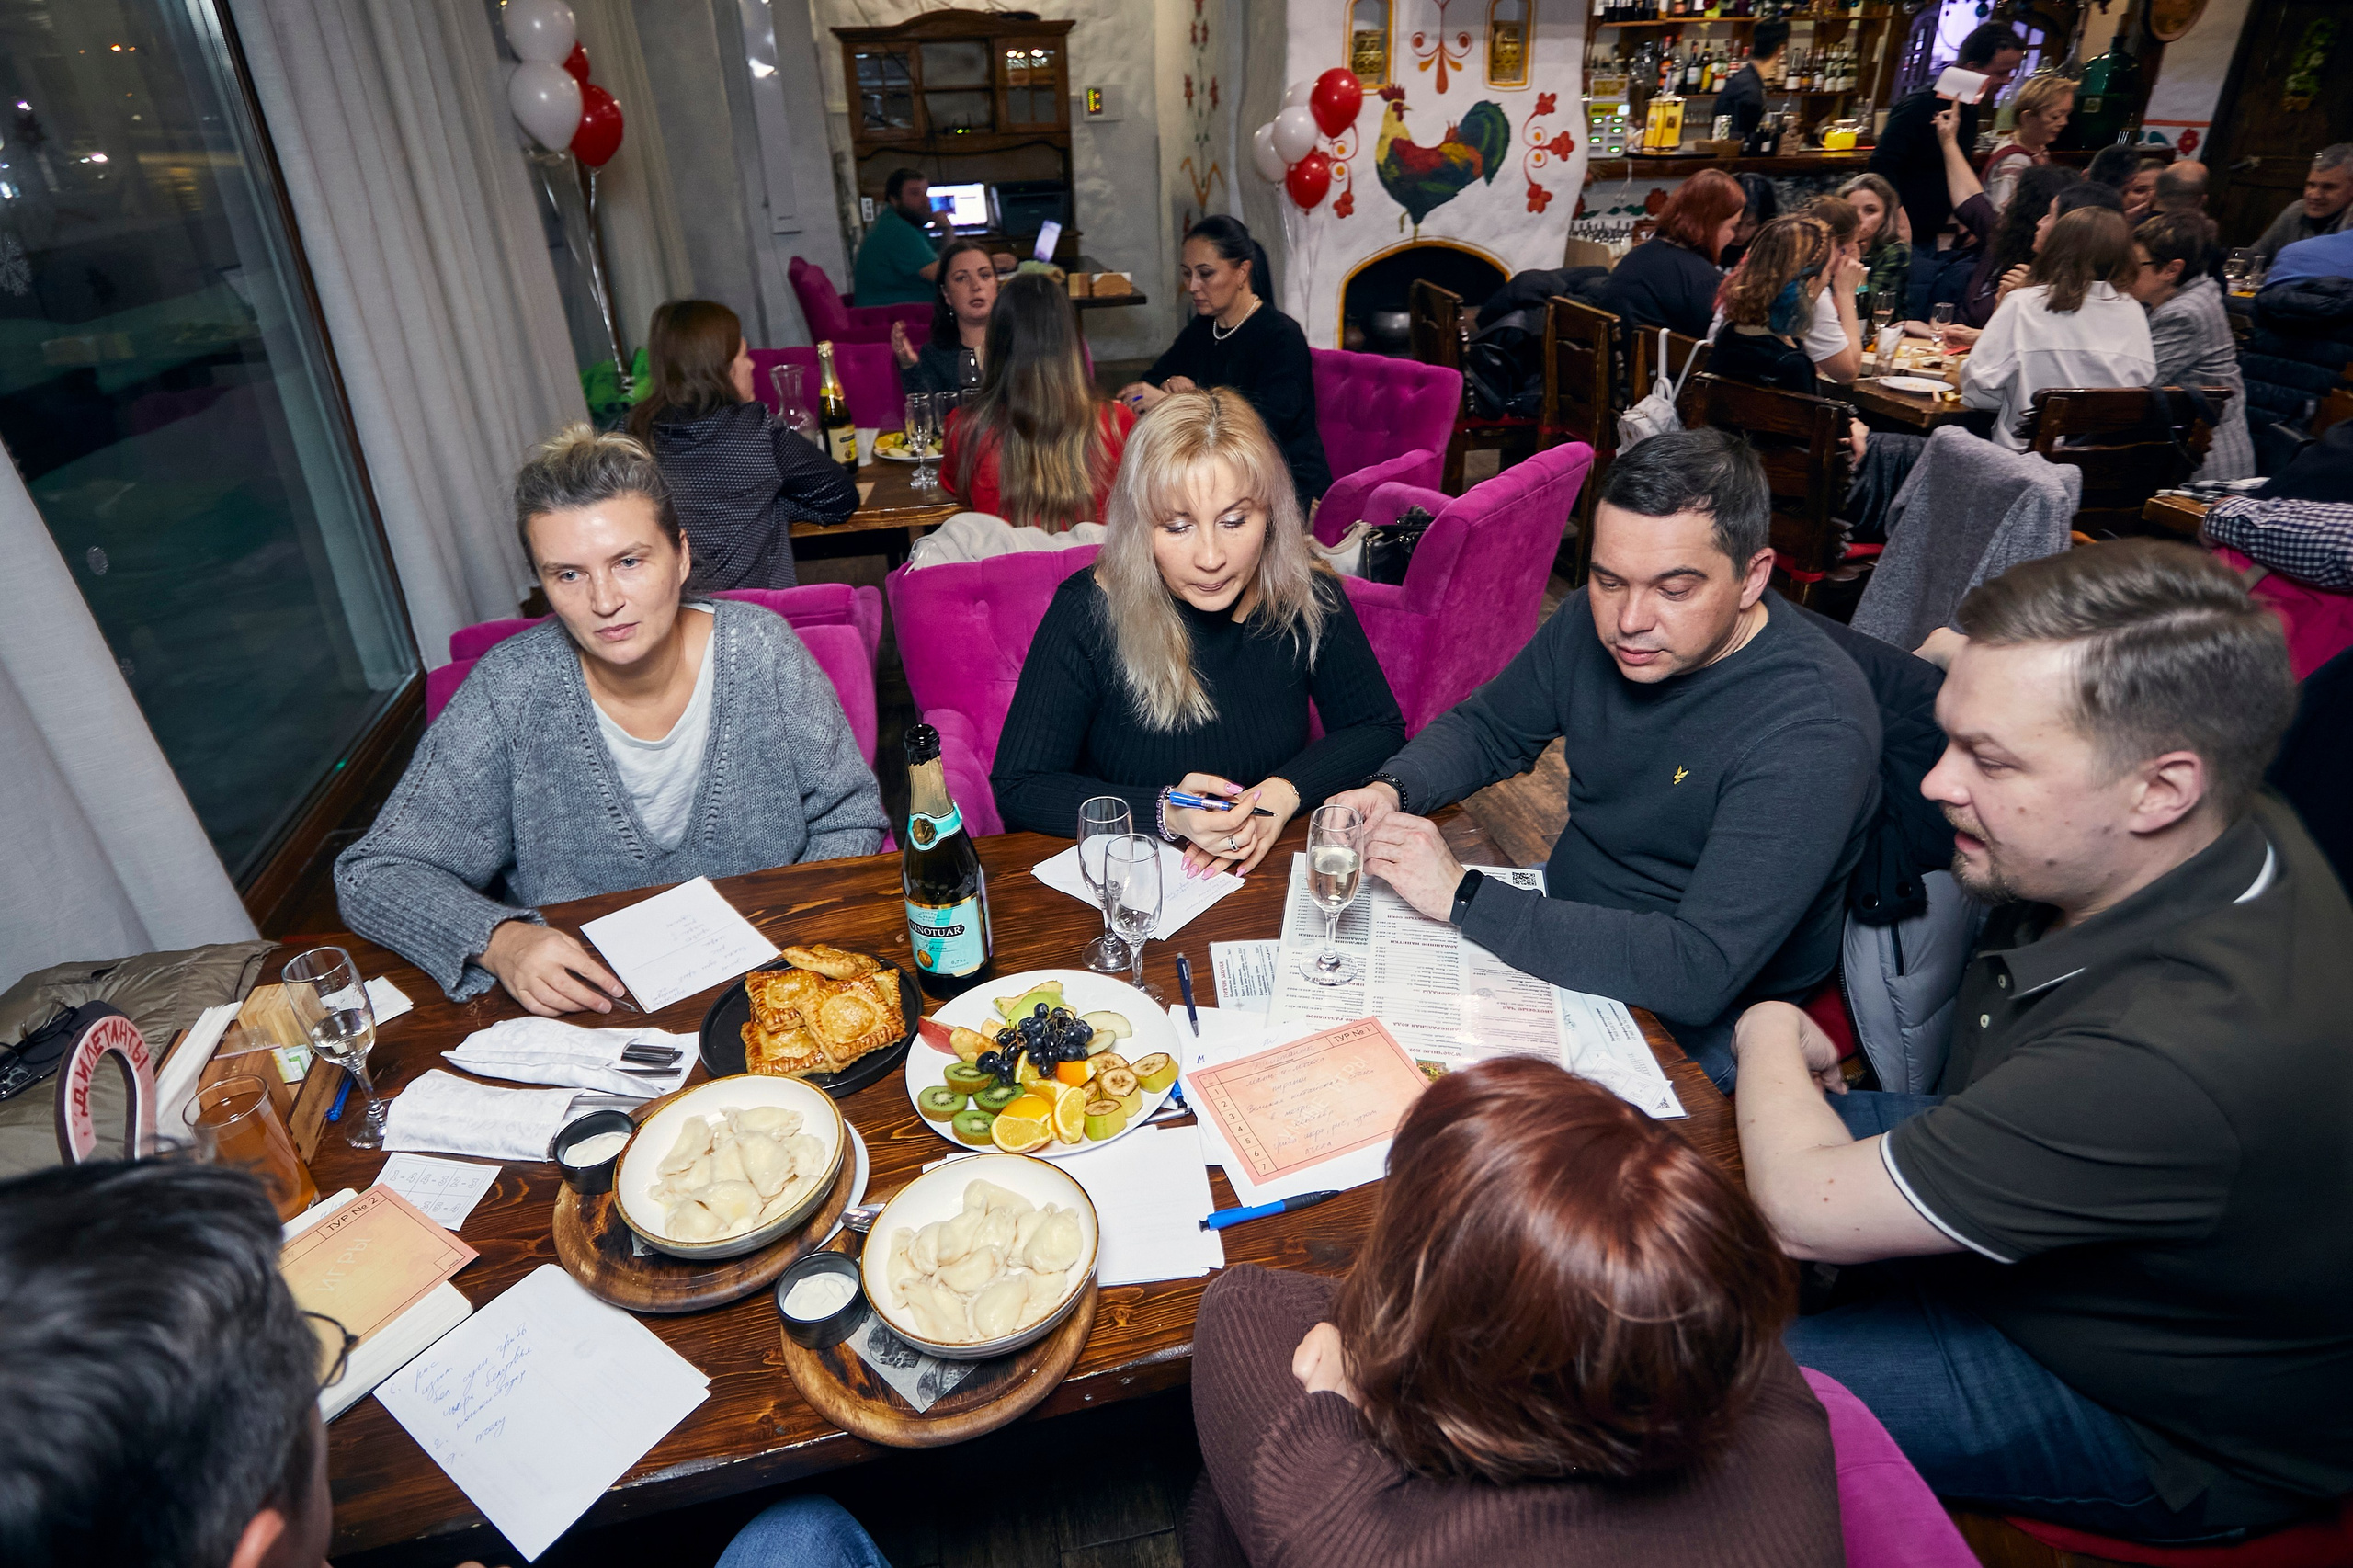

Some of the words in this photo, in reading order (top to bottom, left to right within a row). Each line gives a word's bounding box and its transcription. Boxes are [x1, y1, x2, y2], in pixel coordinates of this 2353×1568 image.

[910, 921, 961, 936] VINOTUAR
[1333, 1031, 1351, 1044] ТУР
[1352, 1028, 1367, 1039] №
[74, 1019, 150, 1118] ДИЛЕТАНТЫ
[1213, 1087, 1220, 1096] 1
[1220, 1100, 1229, 1108] 2
[1228, 1112, 1236, 1120] 3
[1245, 1137, 1253, 1145] 5
[1253, 1150, 1261, 1158] 6
[1260, 1163, 1268, 1171] 7
[325, 1213, 350, 1233] ТУР
[350, 1202, 369, 1217] №
[368, 1196, 380, 1206] 2
